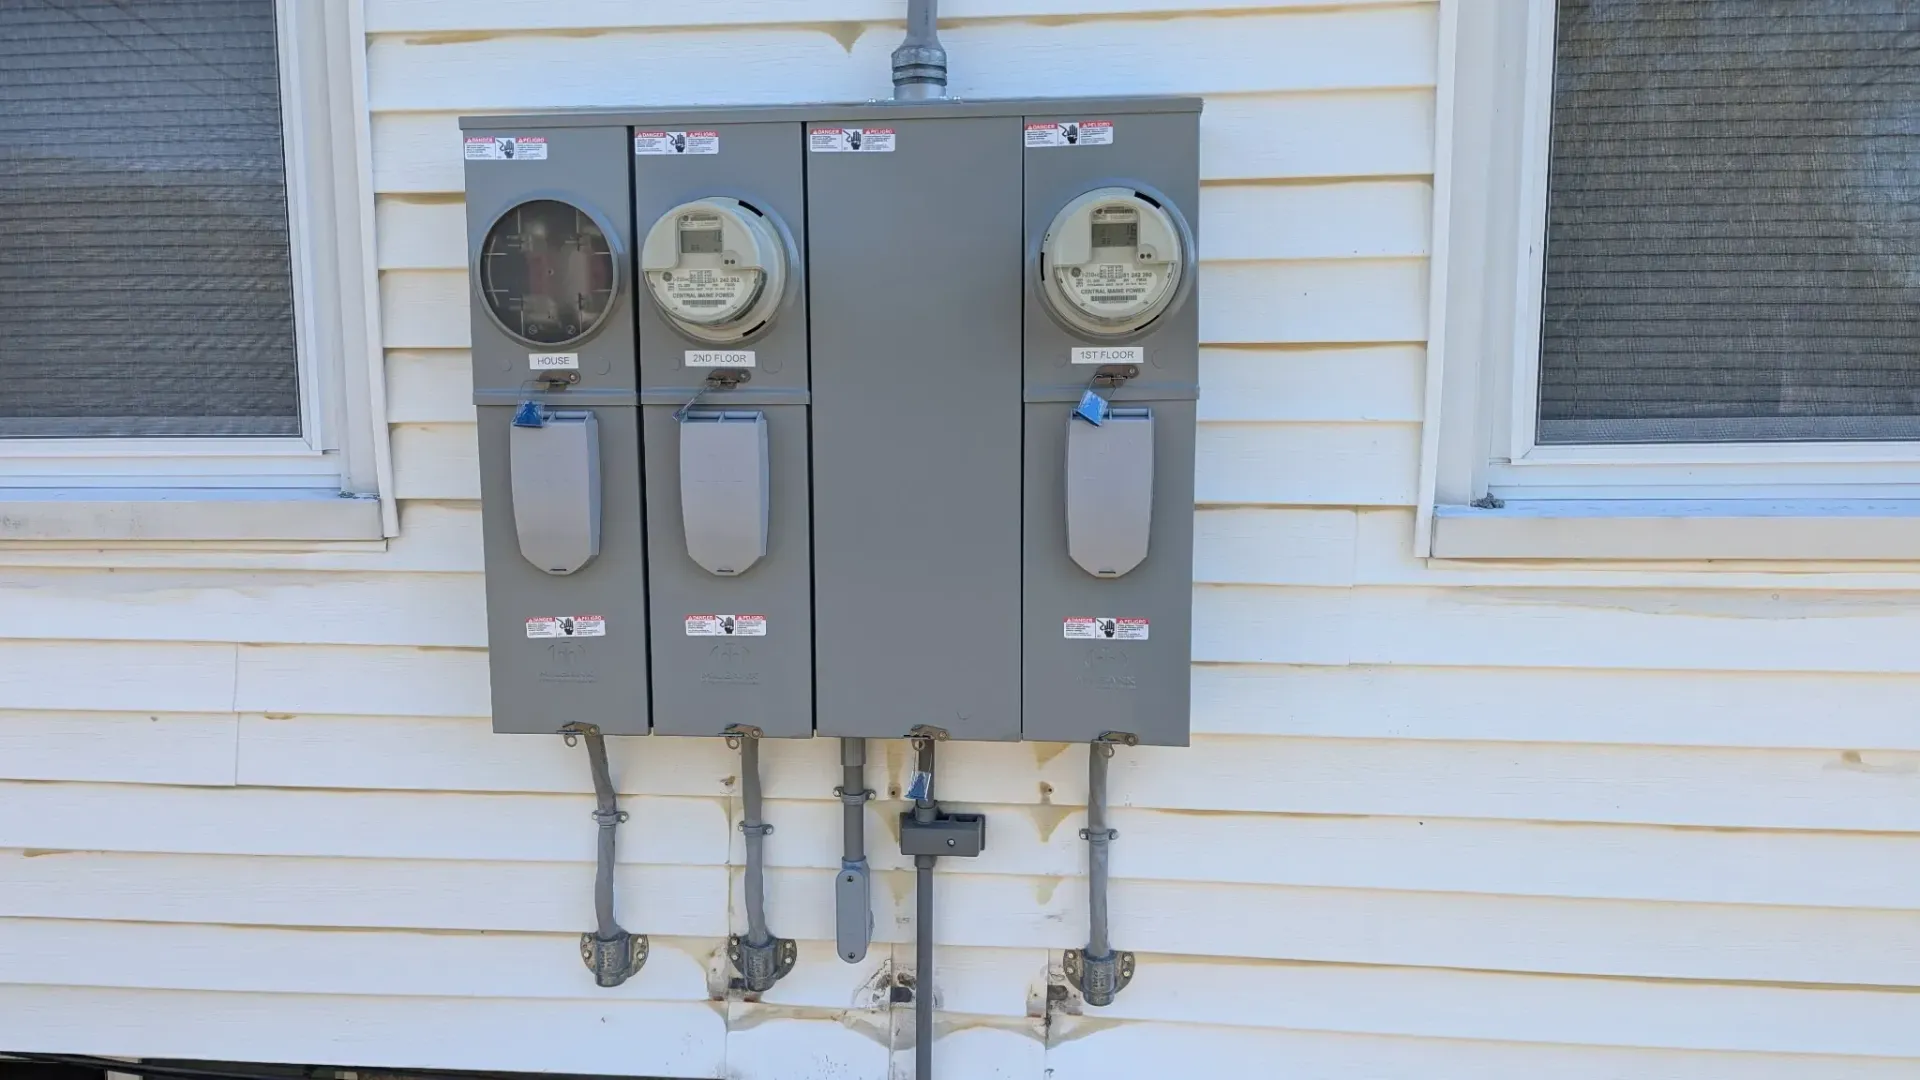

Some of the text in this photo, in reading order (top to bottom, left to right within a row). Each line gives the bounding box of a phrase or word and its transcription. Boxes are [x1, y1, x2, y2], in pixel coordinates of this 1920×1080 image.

[693, 354, 747, 363] 2ND FLOOR
[1080, 350, 1134, 359] 1ST FLOOR
[537, 356, 570, 365] HOUSE
